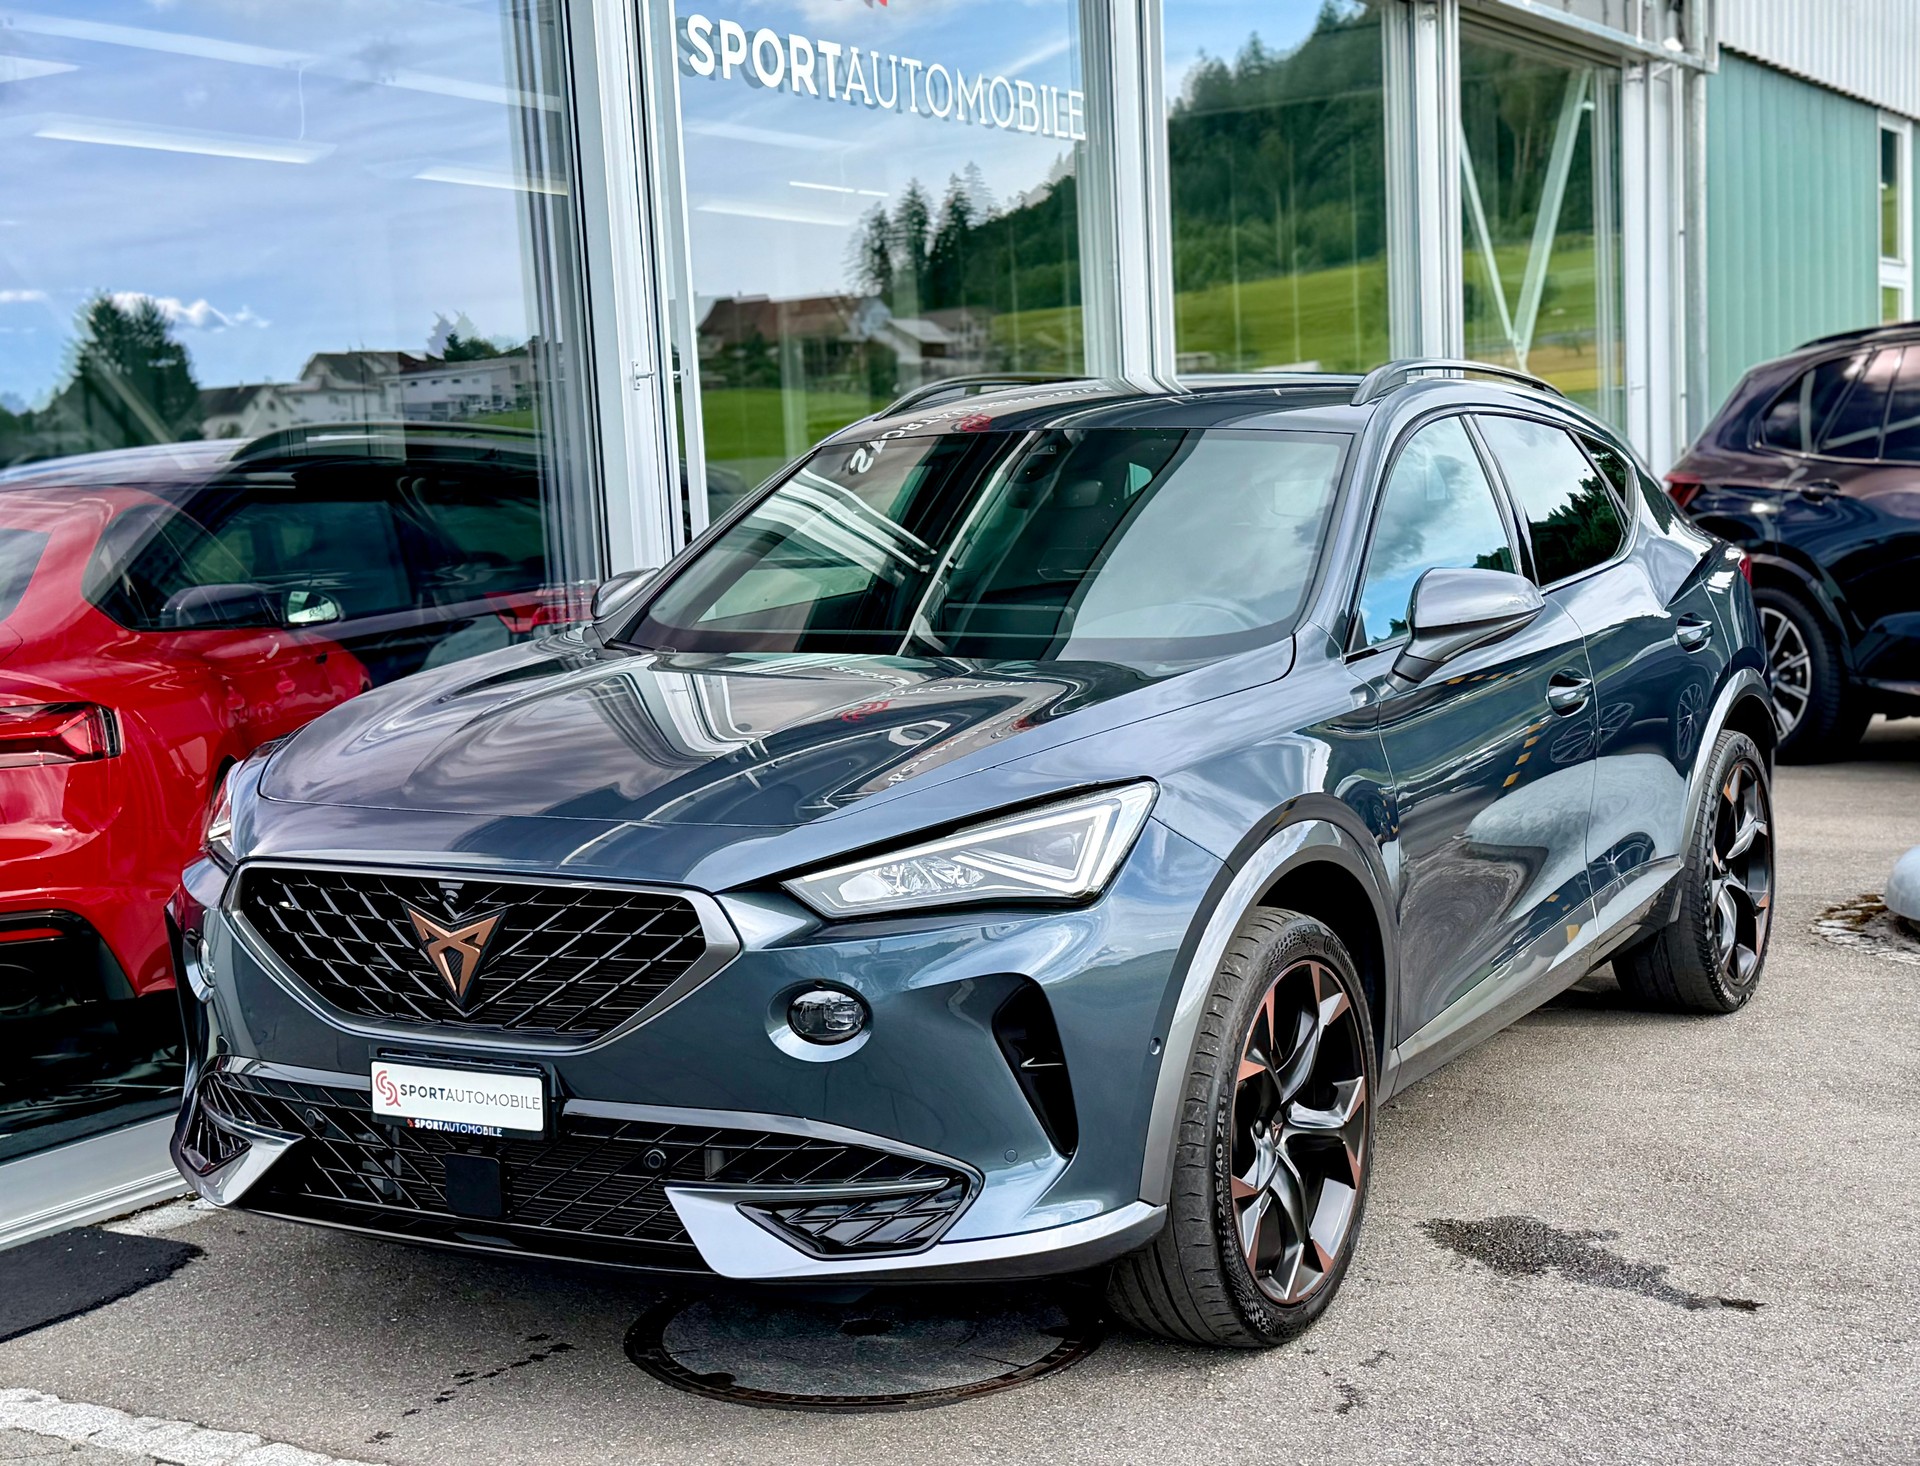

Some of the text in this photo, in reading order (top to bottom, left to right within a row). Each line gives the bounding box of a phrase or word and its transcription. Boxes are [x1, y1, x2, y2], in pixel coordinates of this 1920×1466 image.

[686, 13, 1086, 141] SPORTAUTOMOBILE
[400, 1083, 541, 1110] SPORTAUTOMOBILE
[414, 1119, 503, 1137] SPORTAUTOMOBILE
[1216, 1110, 1226, 1138] ZR
[1215, 1143, 1226, 1219] 245/40
